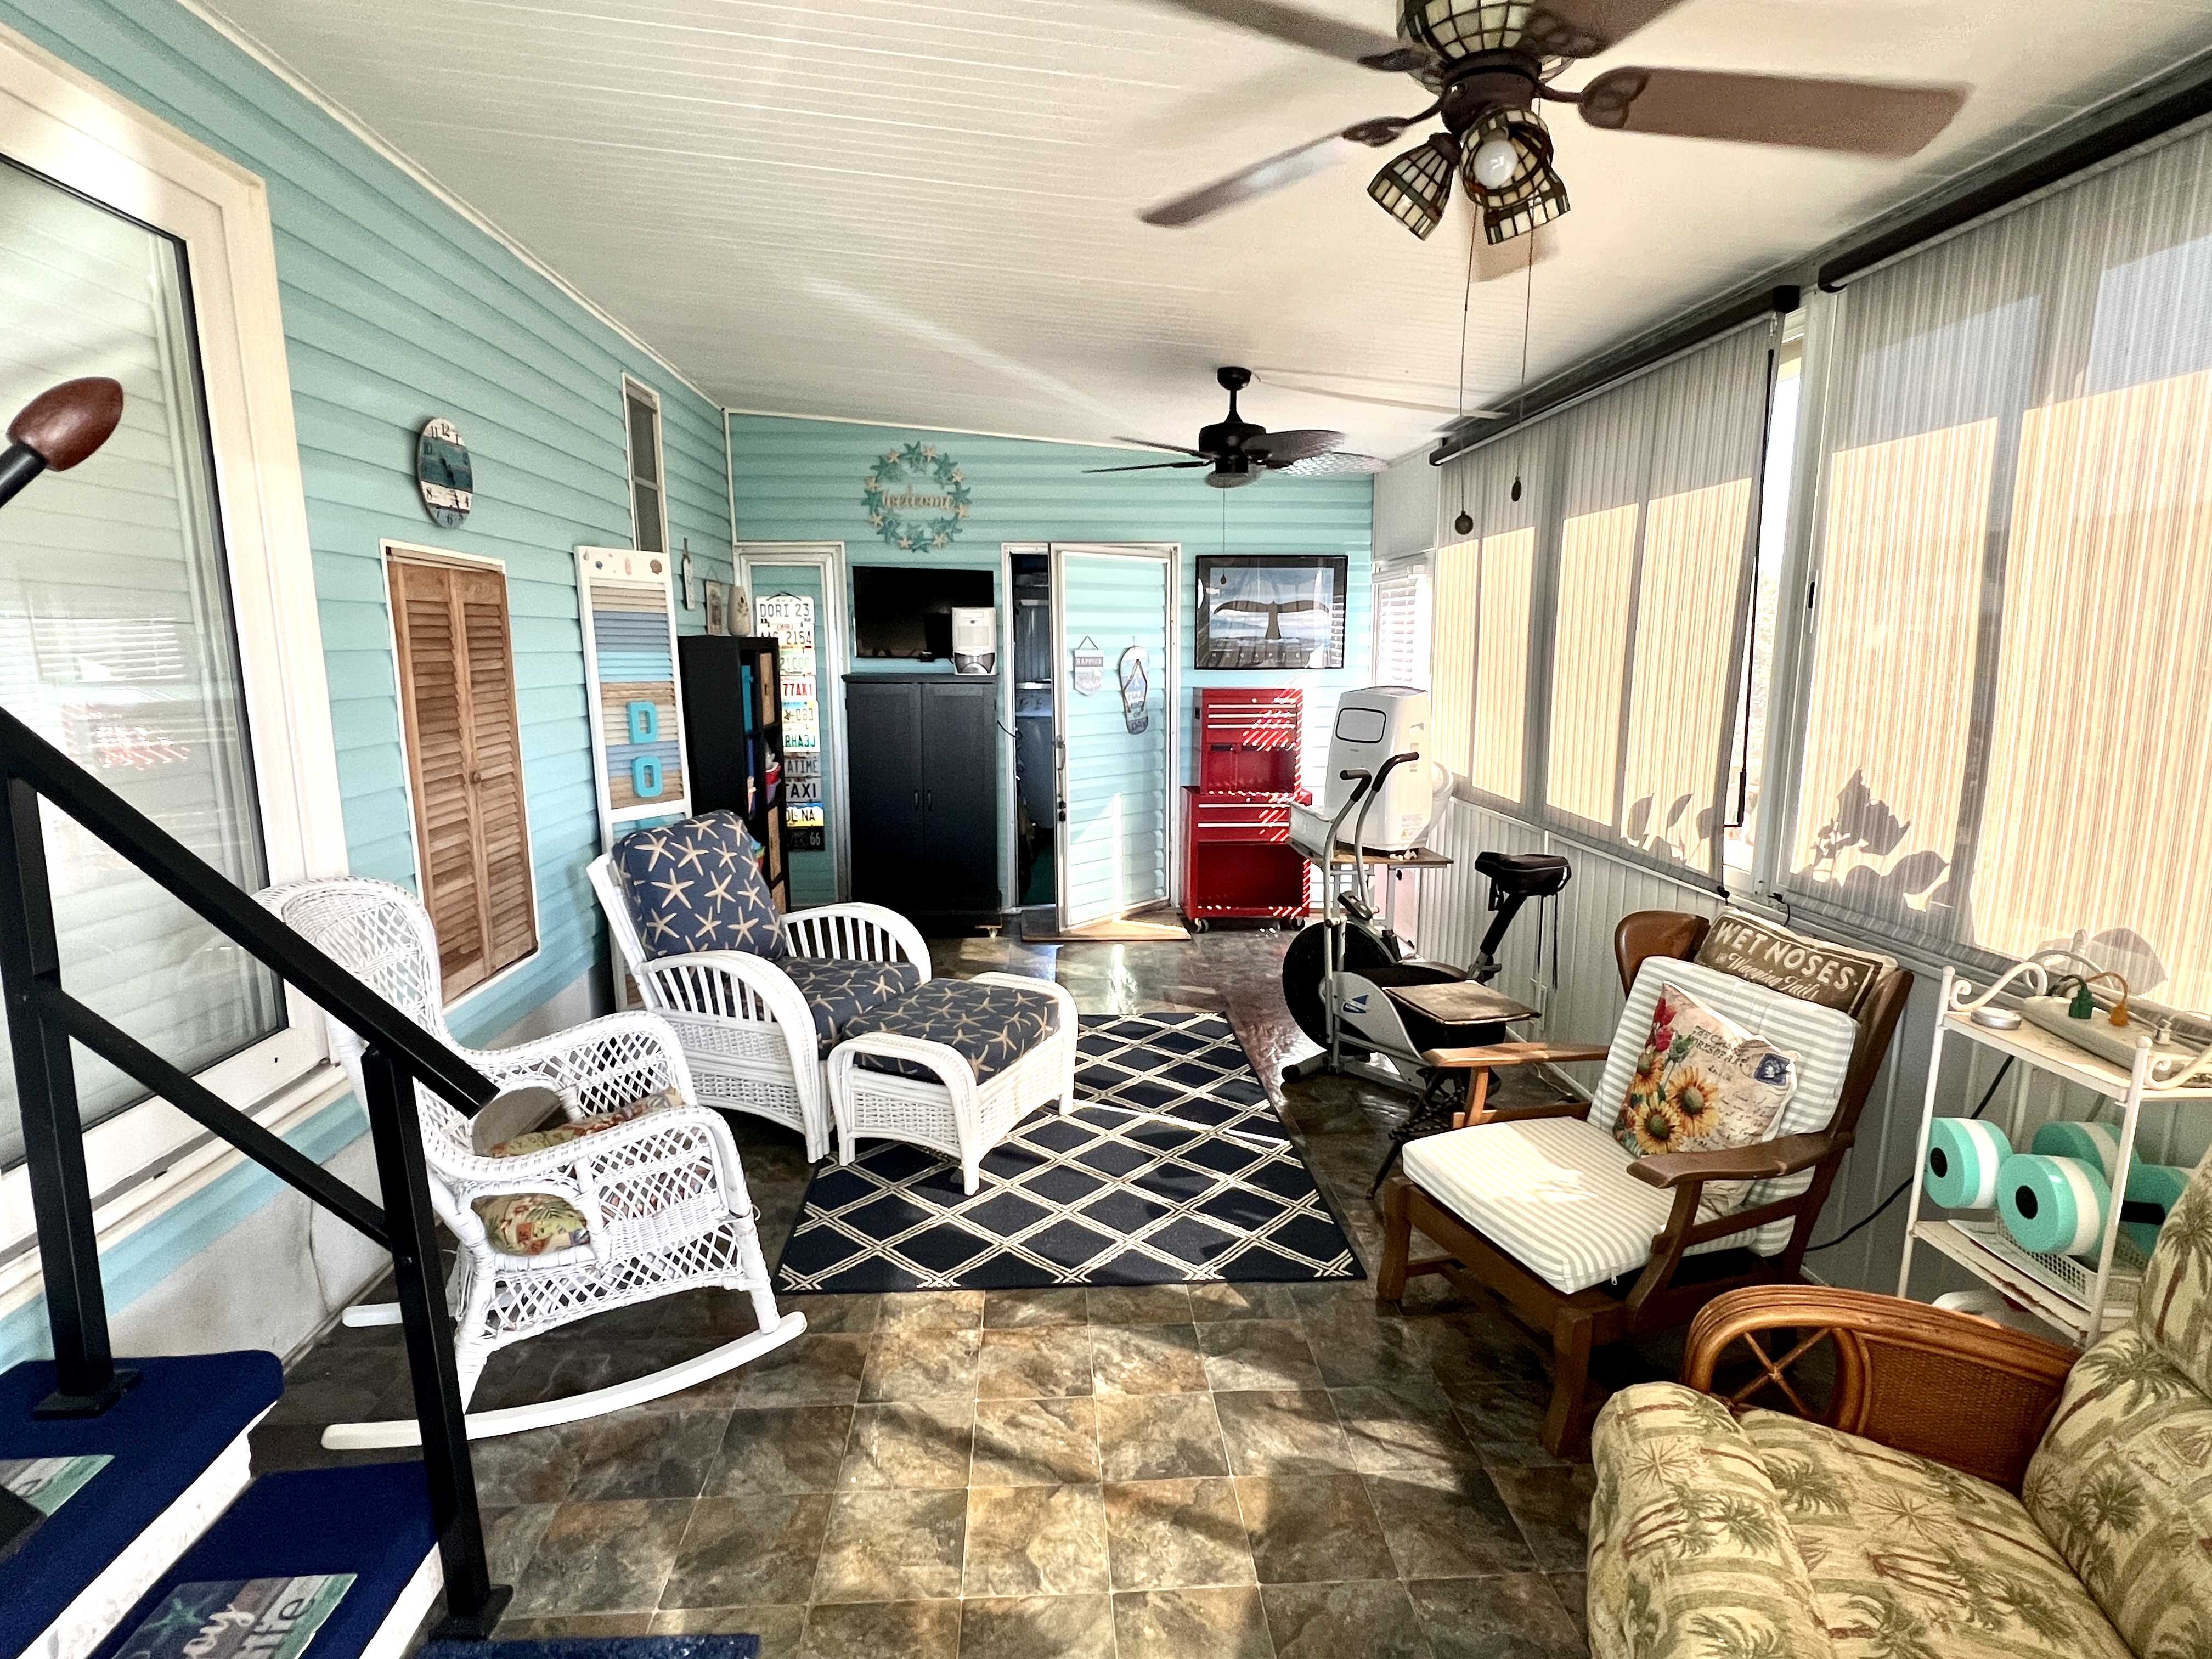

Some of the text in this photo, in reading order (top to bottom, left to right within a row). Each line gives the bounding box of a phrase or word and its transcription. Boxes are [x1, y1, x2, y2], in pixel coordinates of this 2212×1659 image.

[431, 426, 438, 439] 11
[441, 423, 450, 437] 12
[424, 441, 433, 455] 10
[426, 487, 432, 500] 8
[447, 514, 453, 526] 6
[760, 603, 810, 617] DORI 23
[786, 631, 811, 645] 2154
[810, 832, 821, 846] 66
[1714, 921, 1855, 992] WET NOSES
[235, 1598, 315, 1659] ife
